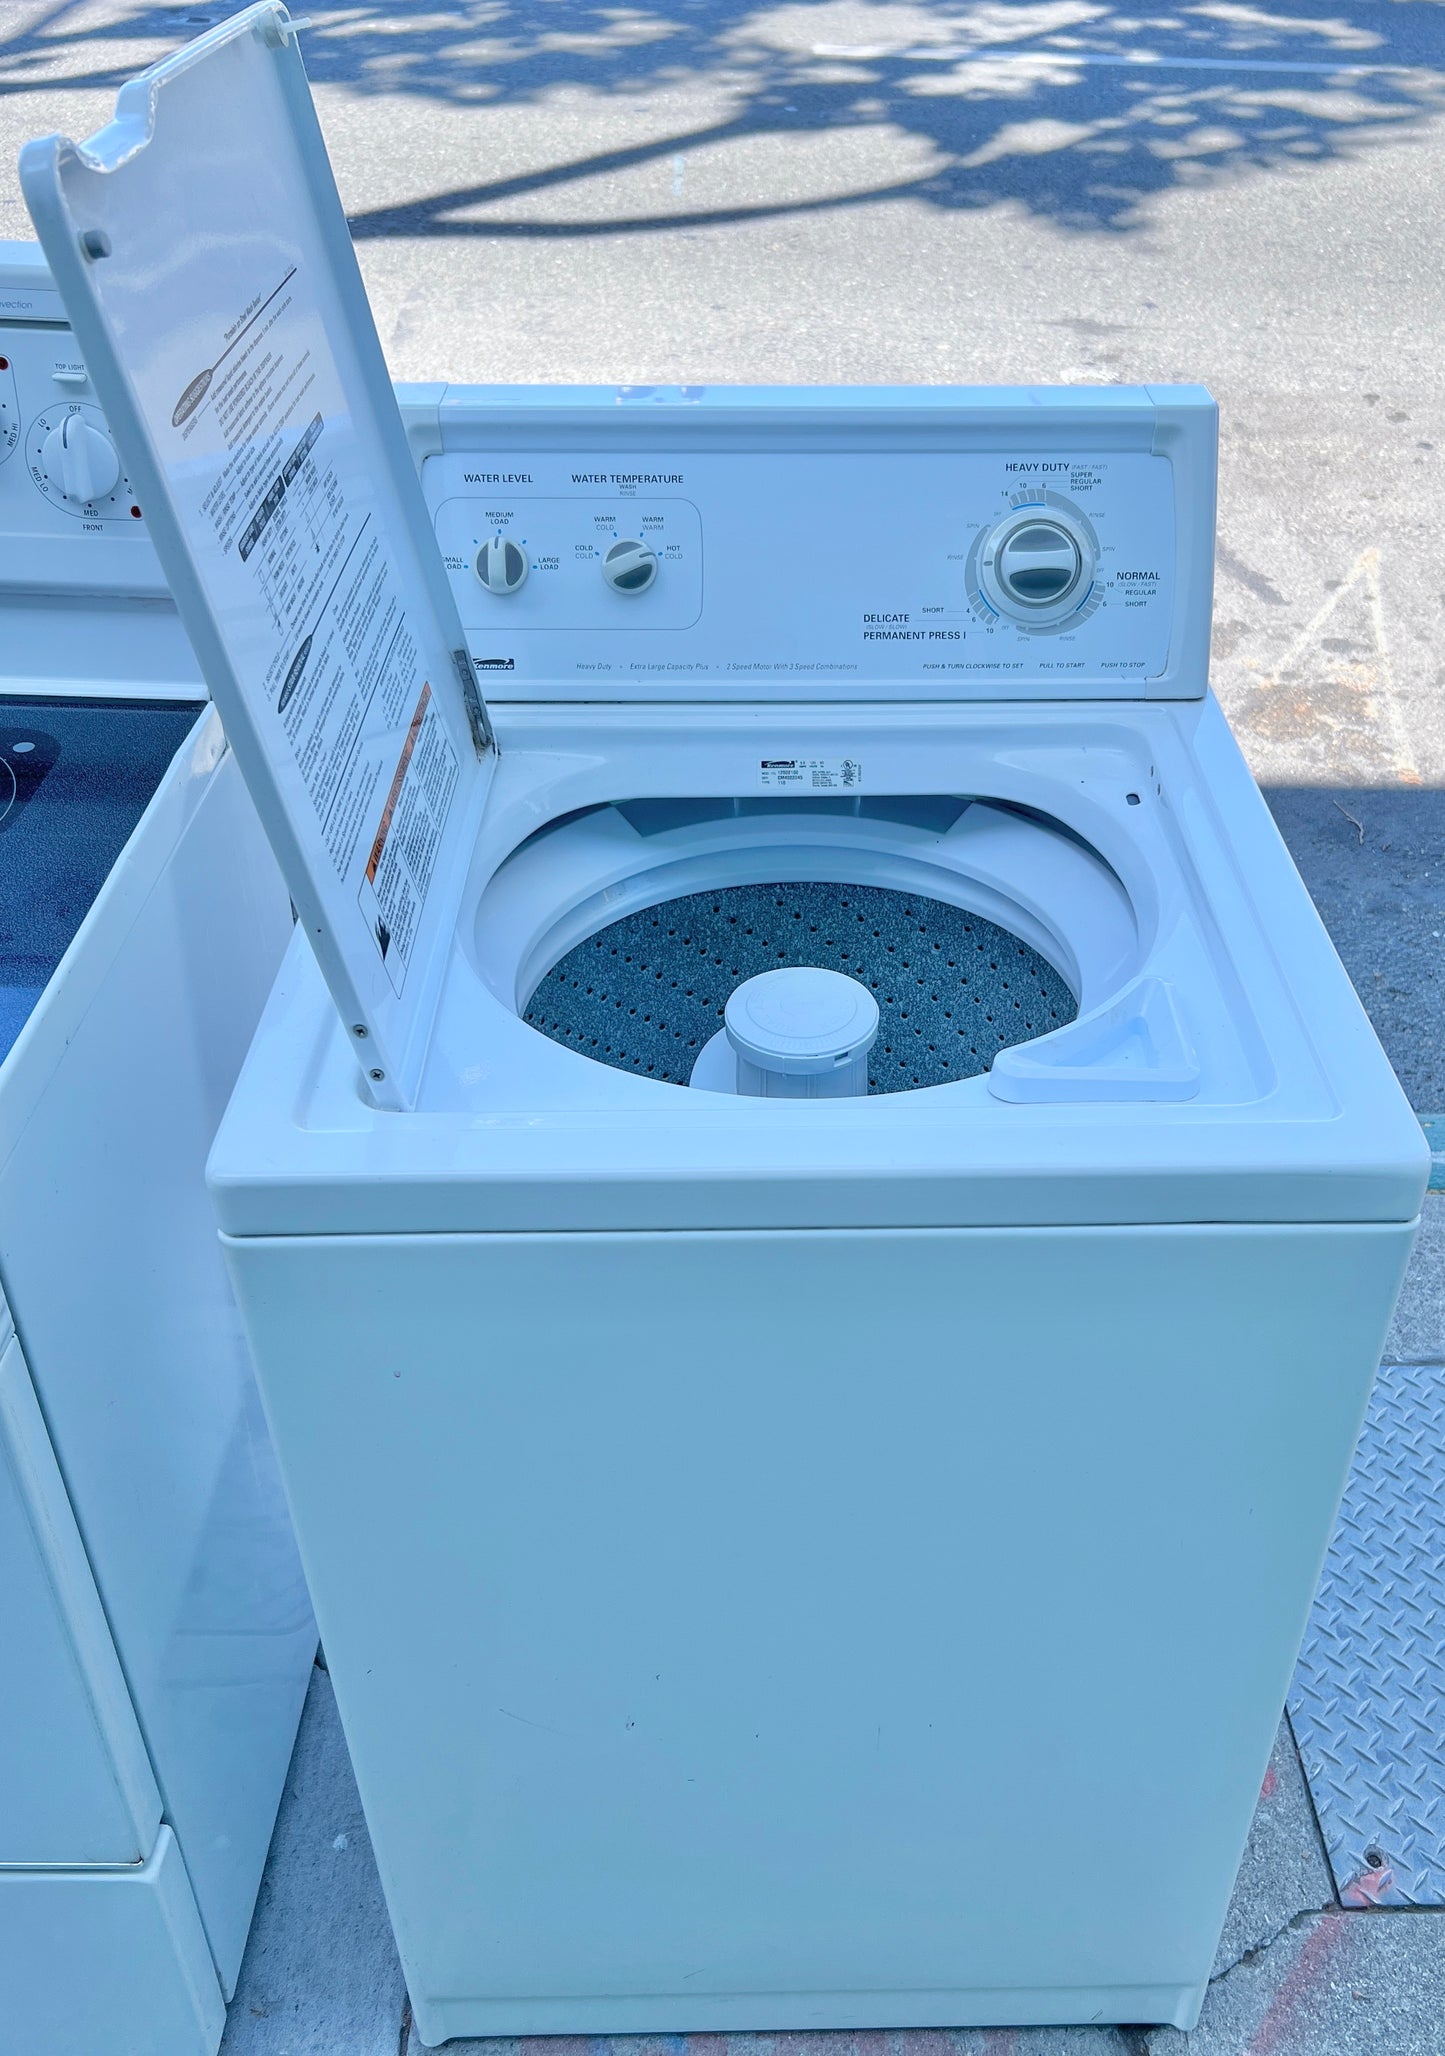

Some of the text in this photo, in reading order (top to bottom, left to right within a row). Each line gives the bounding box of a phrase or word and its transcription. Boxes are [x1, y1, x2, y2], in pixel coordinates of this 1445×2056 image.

[7, 432, 18, 448] MED
[1006, 463, 1040, 472] HEAVY
[1042, 463, 1070, 472] DUTY
[32, 466, 48, 492] MED LO
[464, 474, 534, 483] WATER LEVEL
[572, 474, 684, 484] WATER TEMPERATURE
[1116, 572, 1160, 580] NORMAL
[863, 614, 910, 623] DELICATE
[863, 631, 926, 640] PERMANENT
[929, 631, 960, 639] PRESS
